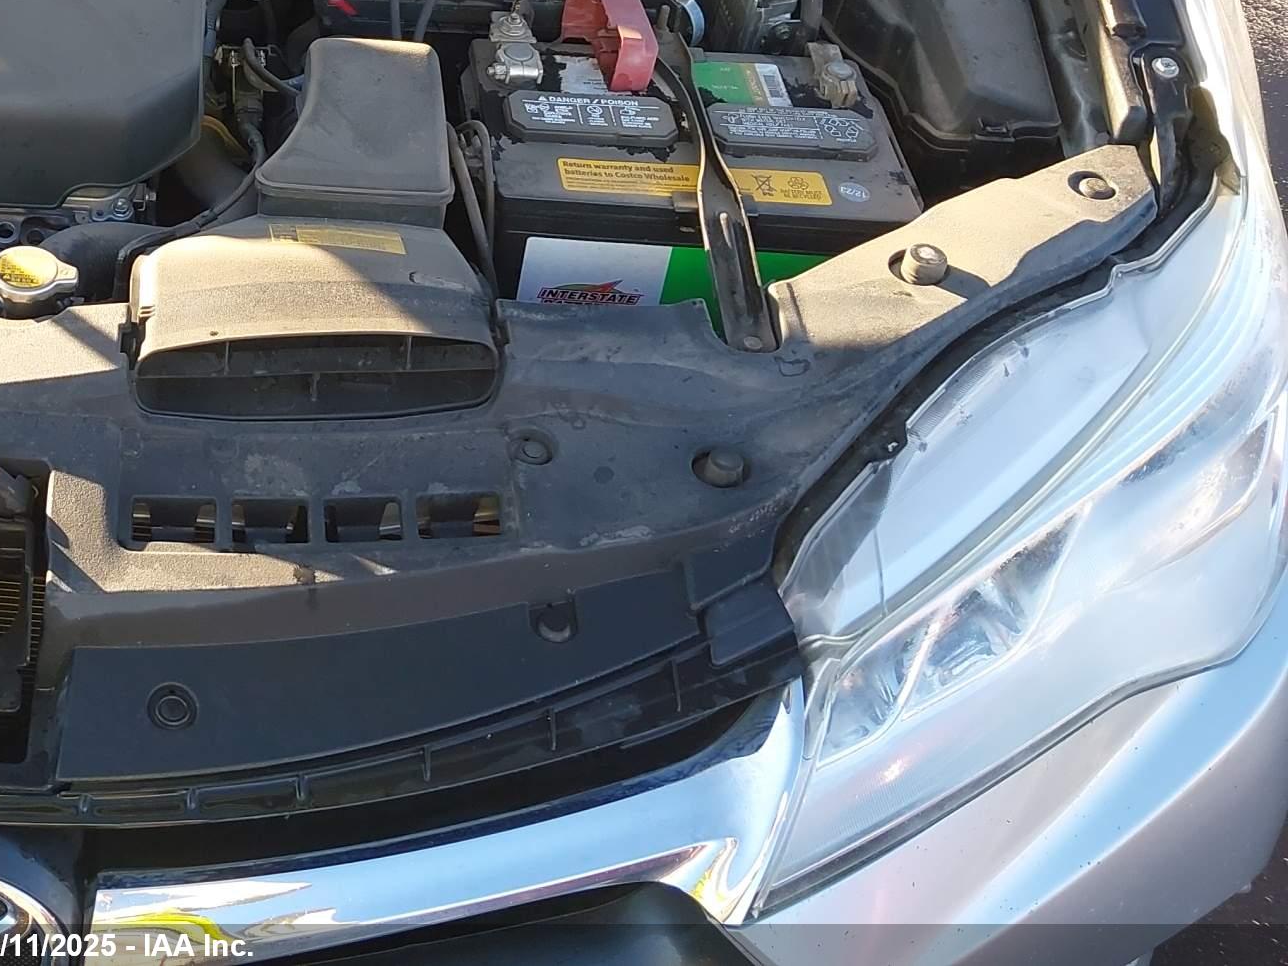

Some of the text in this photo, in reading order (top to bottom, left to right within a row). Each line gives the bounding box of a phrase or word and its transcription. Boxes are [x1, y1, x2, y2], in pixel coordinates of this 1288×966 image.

[548, 96, 591, 104] DANGER
[600, 98, 639, 106] POISON
[562, 160, 593, 169] Return
[593, 162, 633, 173] warranty
[634, 165, 651, 173] and
[564, 168, 691, 182] batteries to Costco Wholesale
[538, 289, 639, 304] INTERSTATE
